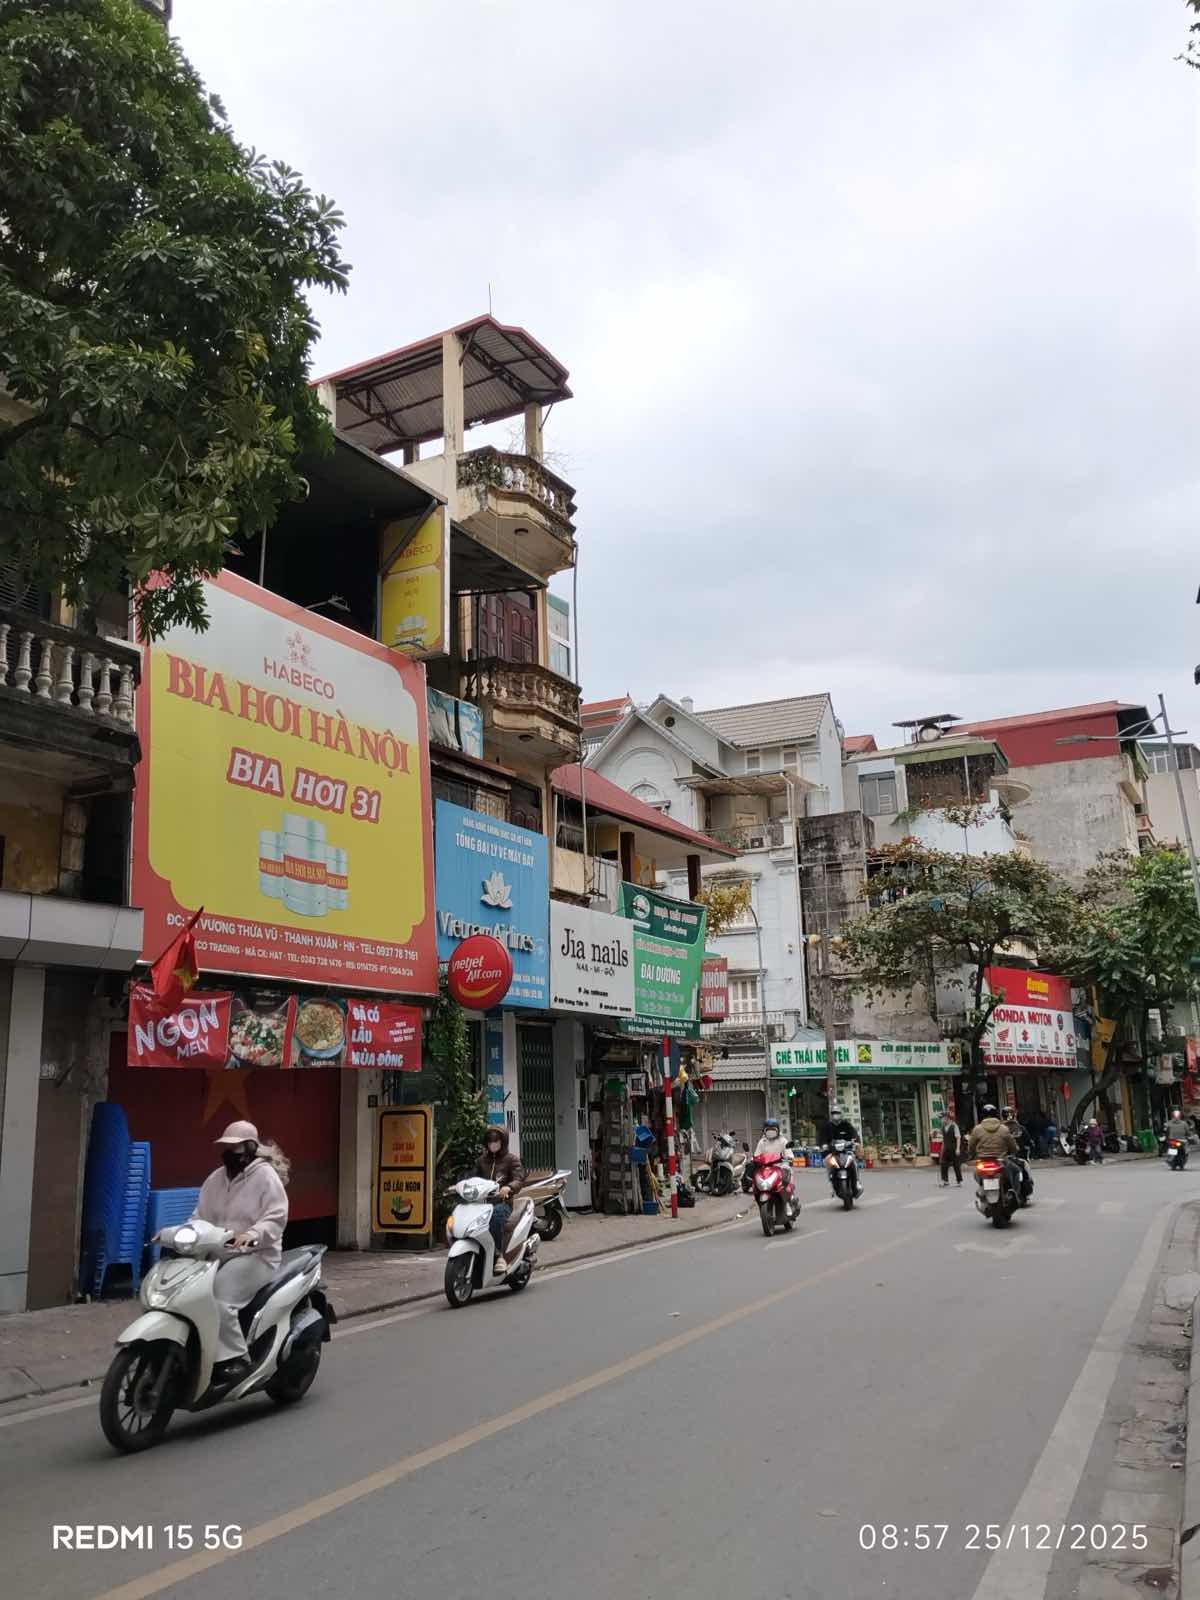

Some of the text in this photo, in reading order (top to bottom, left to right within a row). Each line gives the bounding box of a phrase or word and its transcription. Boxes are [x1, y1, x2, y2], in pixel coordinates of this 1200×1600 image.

[264, 656, 335, 700] HABECO
[166, 653, 234, 716] BIA
[308, 708, 356, 758] HÀ
[357, 724, 411, 778] NỘI
[230, 751, 281, 794] BIA
[352, 789, 381, 820] 31
[167, 913, 185, 927] ĐC:
[264, 927, 278, 940] VŨ
[284, 931, 314, 947] THANH
[314, 935, 338, 951] XUÂN
[343, 941, 355, 953] HN
[360, 943, 375, 955] TEL:
[209, 942, 240, 954] TRADING
[440, 911, 535, 952] Vietnam Airlines
[561, 927, 585, 959] Jia
[591, 939, 629, 967] nails
[641, 963, 654, 984] ĐẠI
[134, 998, 219, 1056] NGON
[993, 1008, 1052, 1026] HONDA MOTOR
[351, 1048, 375, 1066] MÙA
[377, 1050, 403, 1067] ĐÔNG
[794, 1048, 813, 1064] THÁI
[816, 1046, 849, 1063] NGYÊN
